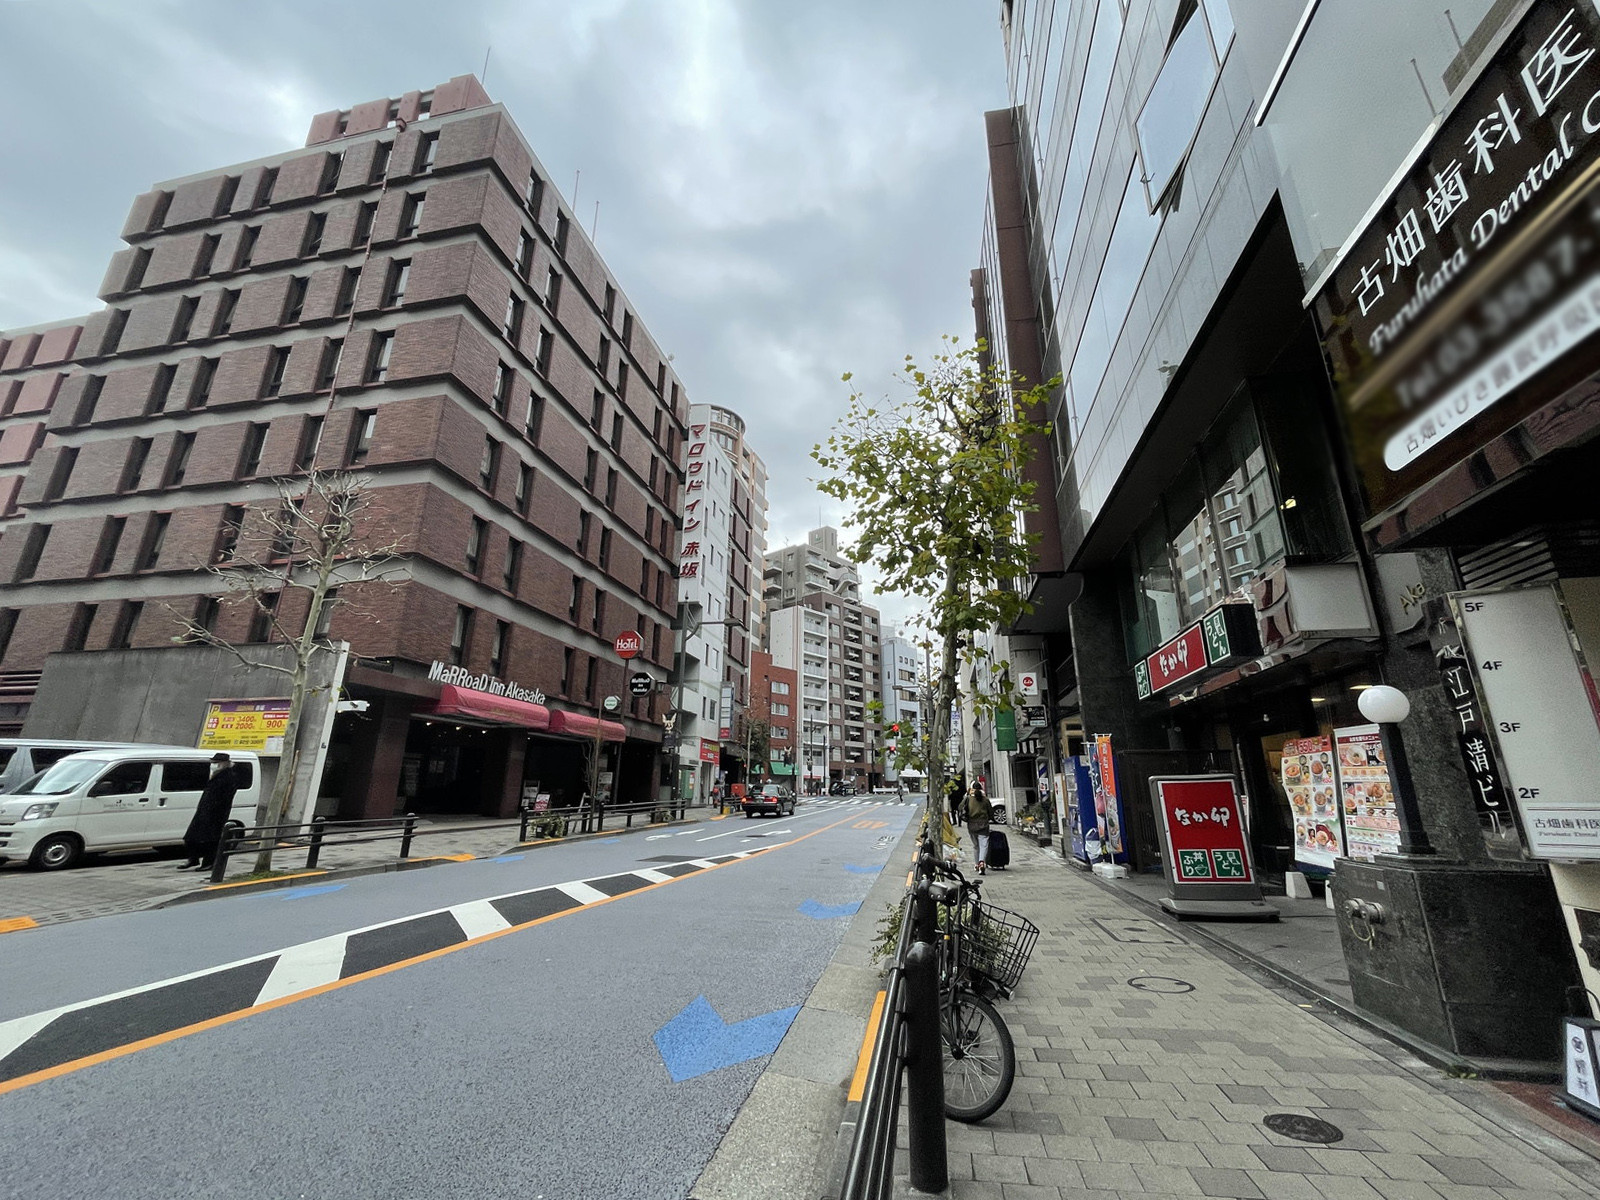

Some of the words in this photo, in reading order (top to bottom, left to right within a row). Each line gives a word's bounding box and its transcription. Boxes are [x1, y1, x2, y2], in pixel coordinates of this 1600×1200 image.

[1351, 8, 1596, 317] 古畑歯科医
[1369, 247, 1468, 356] Furuhata
[1470, 112, 1574, 250] Dental
[1465, 602, 1484, 612] 5F
[1159, 638, 1188, 678] なか卯
[1482, 660, 1502, 671] 4F
[505, 680, 546, 705] Akasaka
[1500, 722, 1520, 733] 3F
[1519, 788, 1540, 799] 2F
[1174, 806, 1231, 829] なか卯
